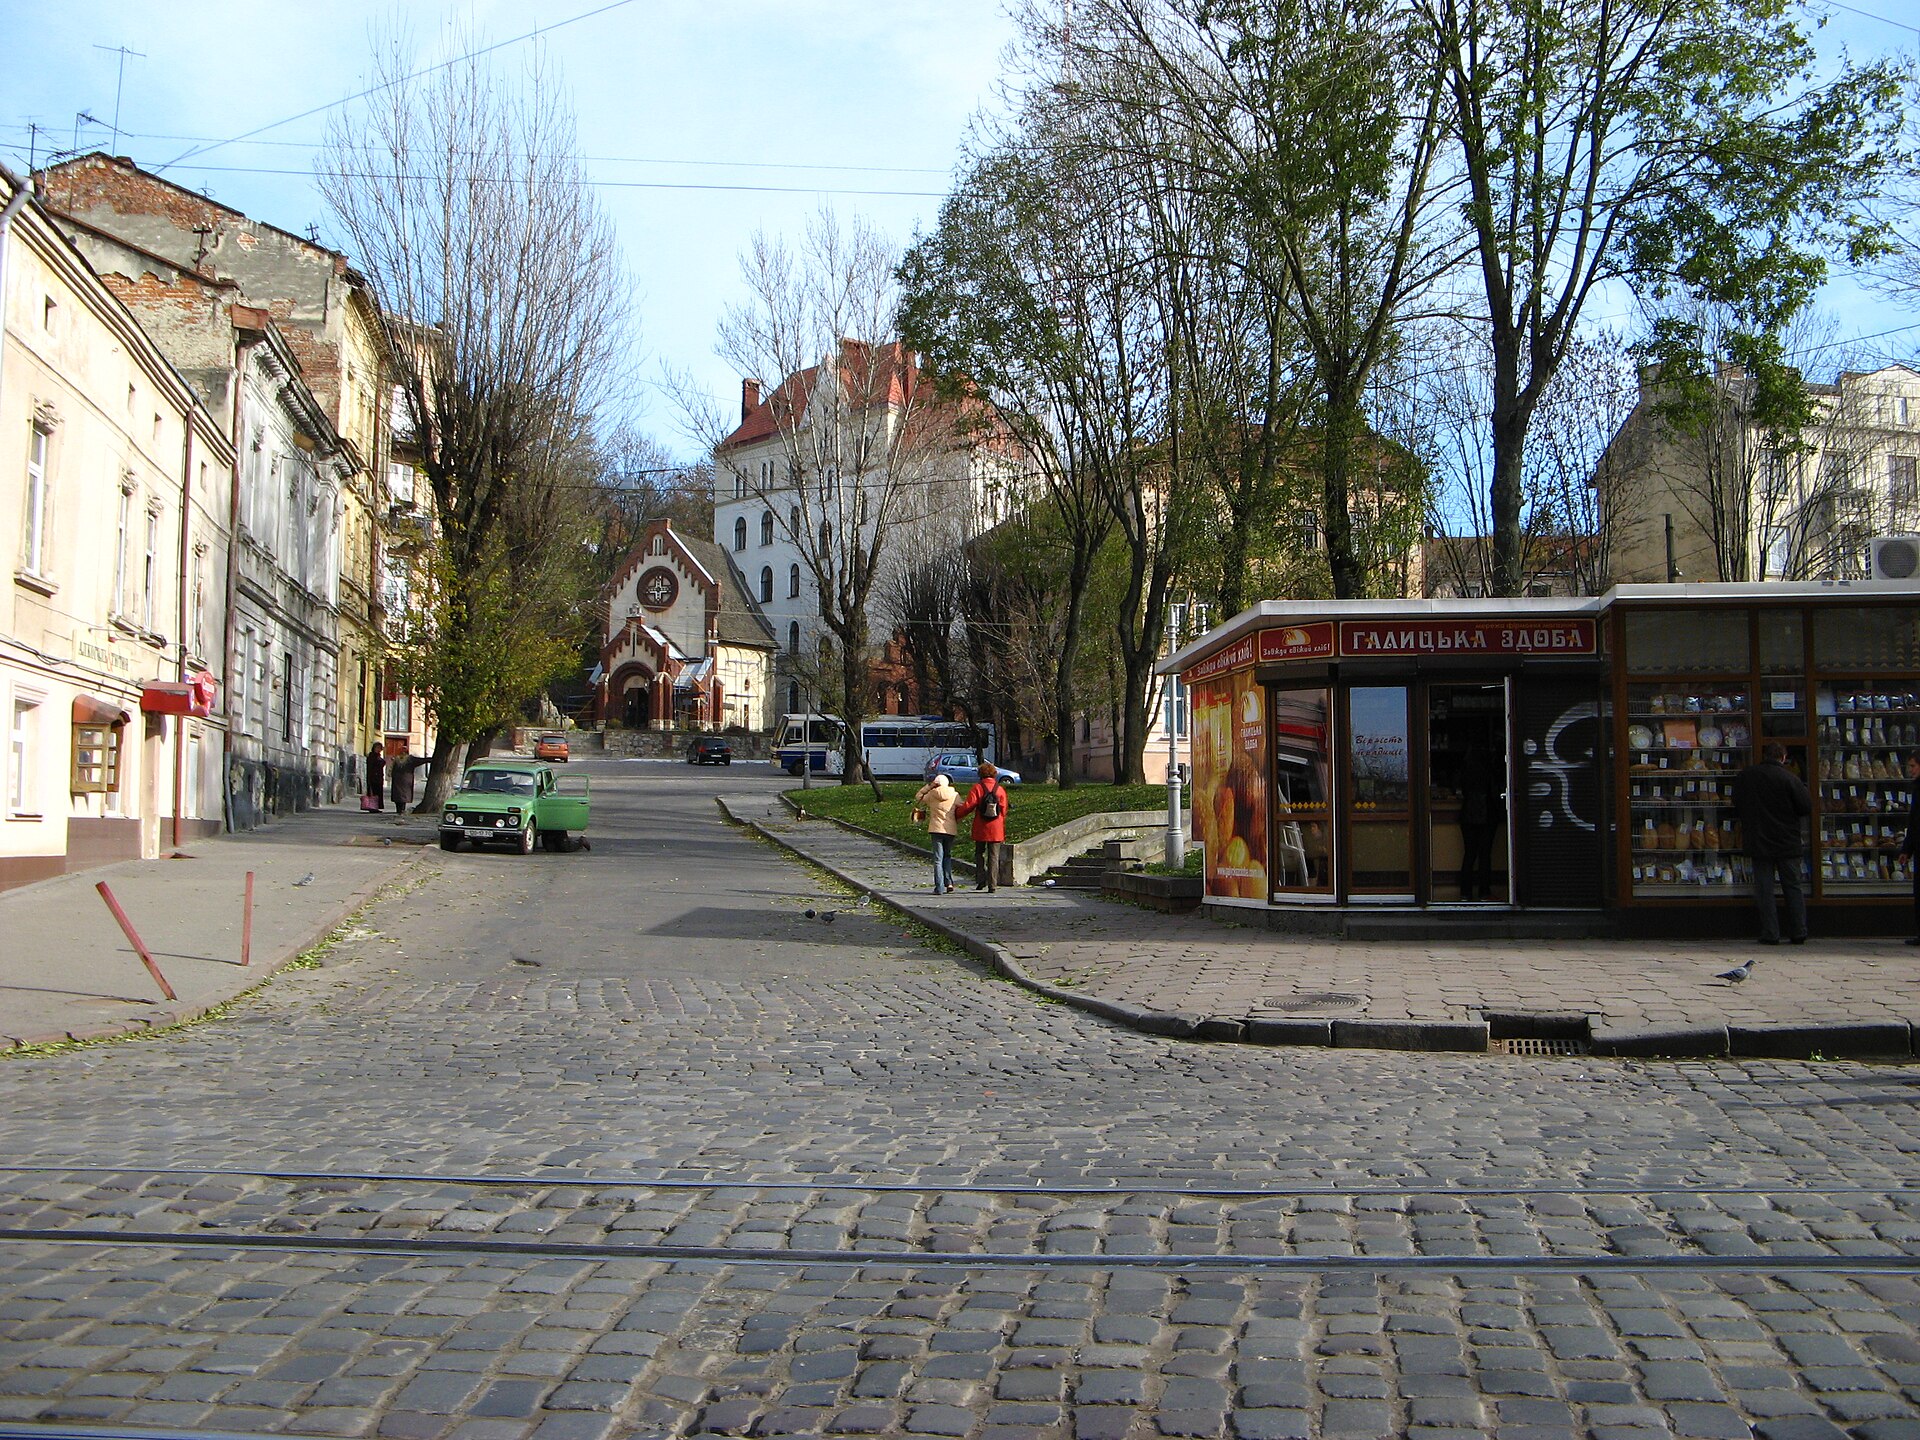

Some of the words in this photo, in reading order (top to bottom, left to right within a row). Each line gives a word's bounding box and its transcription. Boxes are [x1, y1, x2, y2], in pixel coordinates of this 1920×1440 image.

[1353, 631, 1487, 652] ГАЛИЦЬКА
[1502, 629, 1583, 651] ЗДОБА
[1263, 648, 1288, 657] Завжди
[1289, 645, 1312, 654] свіжий
[1314, 643, 1331, 652] хліб!
[1355, 735, 1403, 745] Вірність
